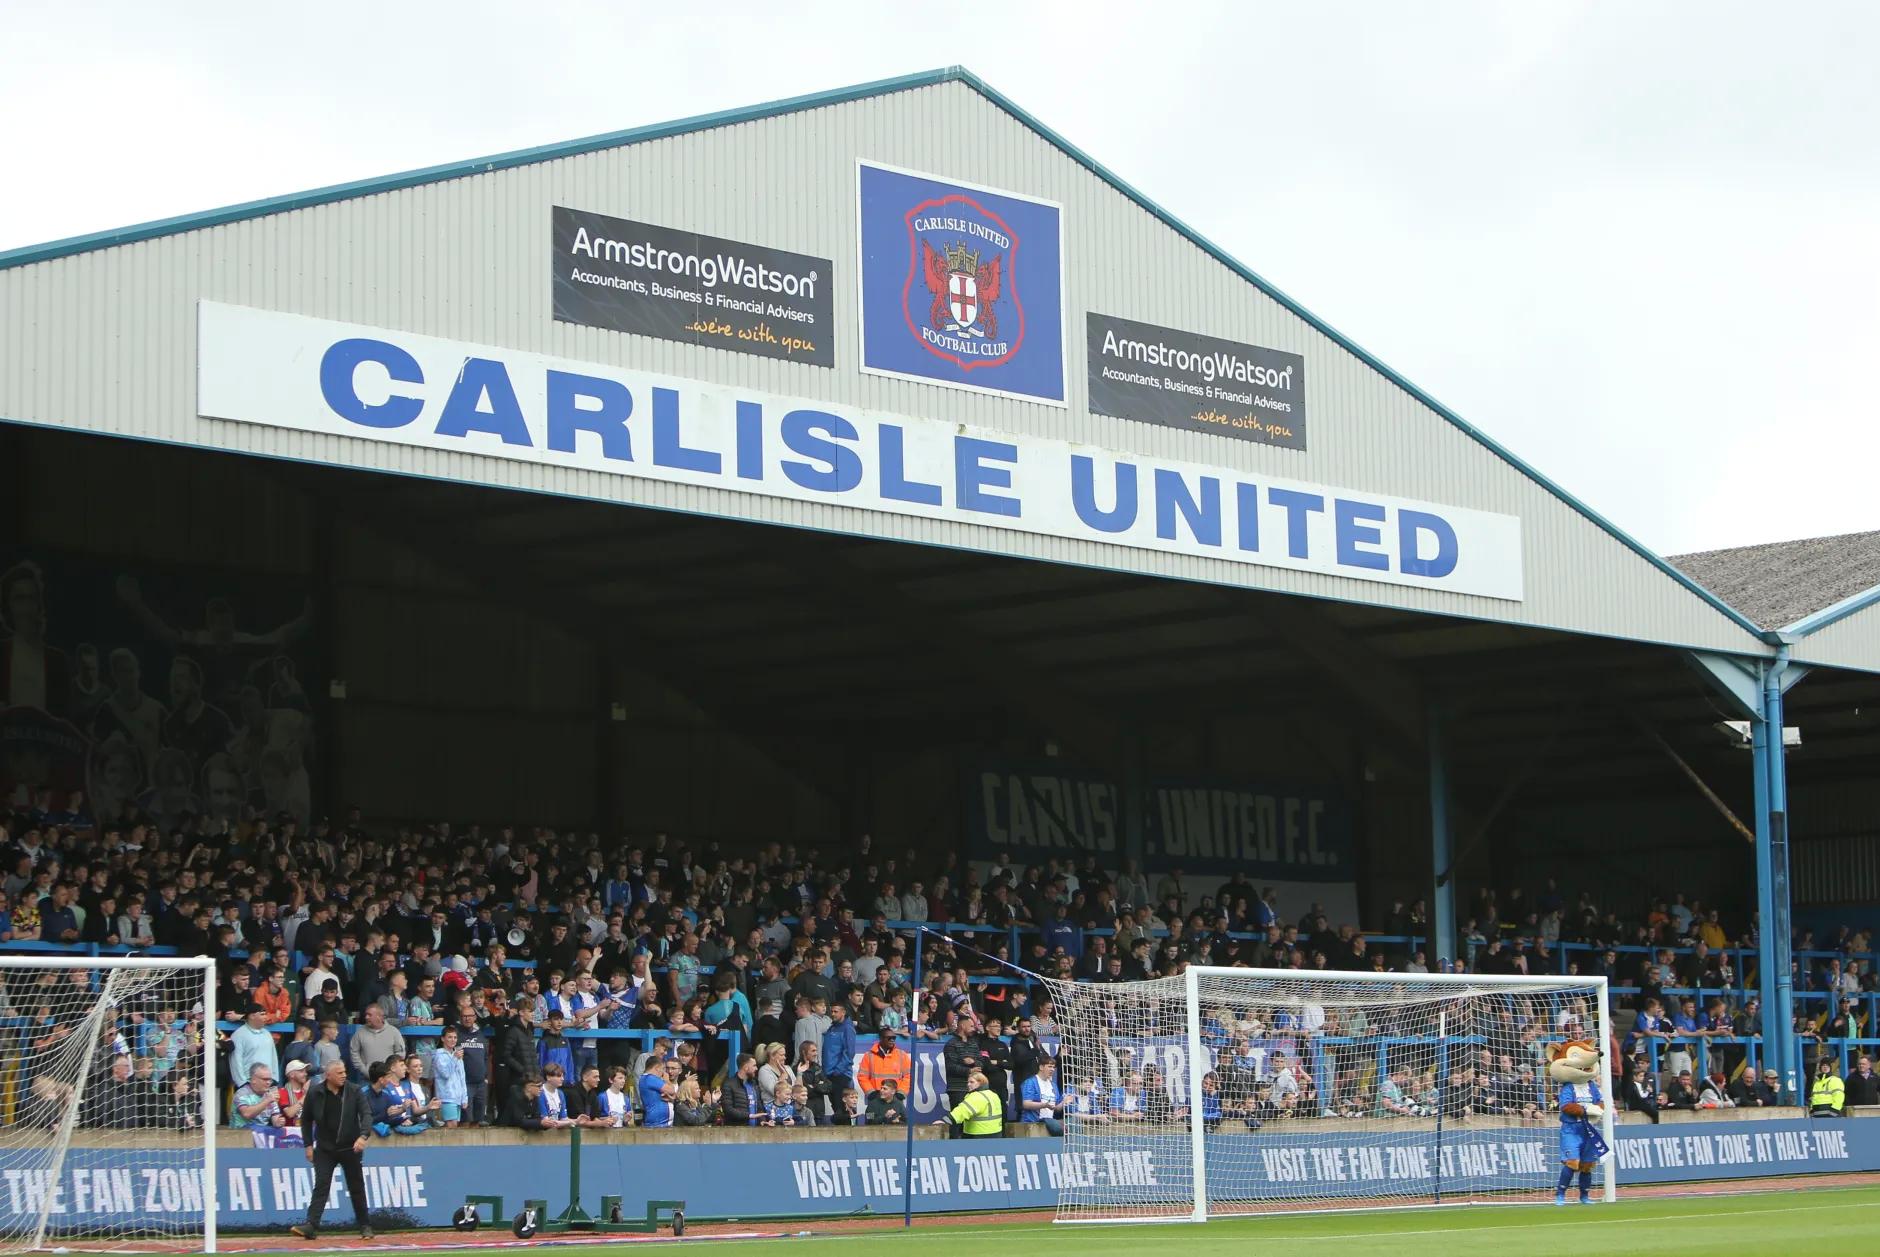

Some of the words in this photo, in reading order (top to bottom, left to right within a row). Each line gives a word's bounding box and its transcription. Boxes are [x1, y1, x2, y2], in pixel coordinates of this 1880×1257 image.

[915, 217, 967, 232] CARLISLE
[969, 221, 1010, 249] UNITED
[571, 268, 649, 295] Accountants,
[651, 283, 702, 304] Business
[705, 292, 714, 305] &
[716, 295, 764, 314] Financial
[766, 304, 814, 324] Advisers
[738, 323, 777, 344] with
[781, 335, 815, 353] you
[922, 326, 980, 355] FOOTBALL
[980, 342, 1008, 356] CLUB
[1102, 366, 1163, 390] Accountants,
[1164, 378, 1204, 397] Business
[1205, 386, 1213, 398] &
[1214, 388, 1252, 405] Financial
[1253, 394, 1292, 412] Advisers
[1231, 412, 1263, 431] with
[1265, 423, 1293, 439] you
[320, 340, 1021, 516] CARLISLE
[1071, 456, 1457, 577] UNITED
[981, 772, 1155, 854] CARLIS
[1157, 788, 1280, 861] UNITED
[1284, 798, 1338, 866] F.C.
[1261, 1148, 1309, 1182] VISIT
[1310, 1147, 1347, 1181] THE
[1348, 1147, 1385, 1180] FAN
[1386, 1146, 1431, 1179] ZONE
[1433, 1145, 1455, 1177] AT
[1457, 1142, 1549, 1177] HALF-TIME
[1615, 1138, 1651, 1170] VISIT
[1653, 1136, 1684, 1168] THE
[1683, 1135, 1715, 1166] FAN
[1714, 1134, 1754, 1164] ZONE
[1754, 1133, 1776, 1162] AT
[1775, 1130, 1849, 1161] HALF-TIME
[3, 1168, 67, 1214] THE
[72, 1168, 135, 1213] FAN
[228, 1167, 262, 1211] AT
[791, 1159, 852, 1199] VISIT
[857, 1158, 903, 1197] THE
[906, 1156, 951, 1195] FAN
[954, 1155, 1011, 1193] ZONE
[1014, 1153, 1041, 1190] AT
[1044, 1150, 1158, 1189] HALF-TIME
